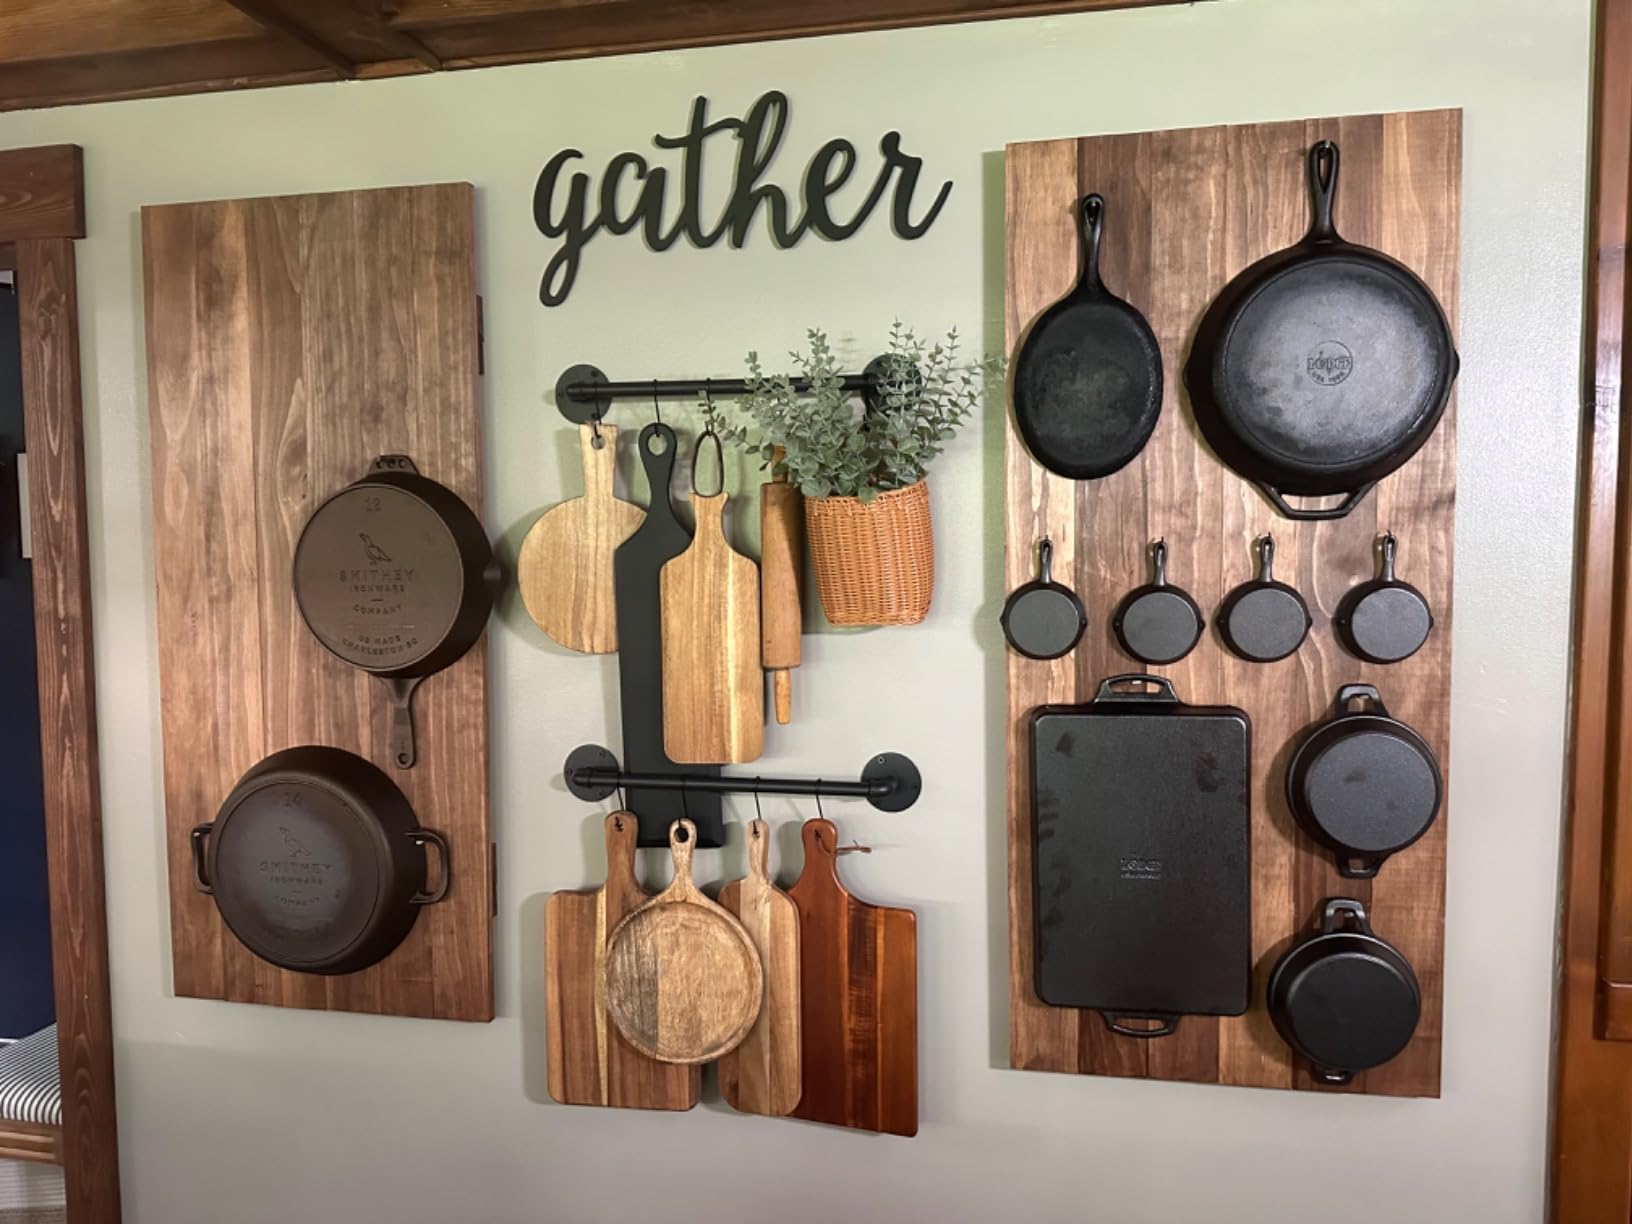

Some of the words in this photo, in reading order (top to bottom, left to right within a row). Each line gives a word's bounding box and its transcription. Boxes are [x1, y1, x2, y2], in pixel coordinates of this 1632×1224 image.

[533, 90, 953, 307] gather
[339, 568, 415, 583] SMITHEY
[353, 603, 402, 616] COMPANY
[258, 861, 336, 874] SMITHEY
